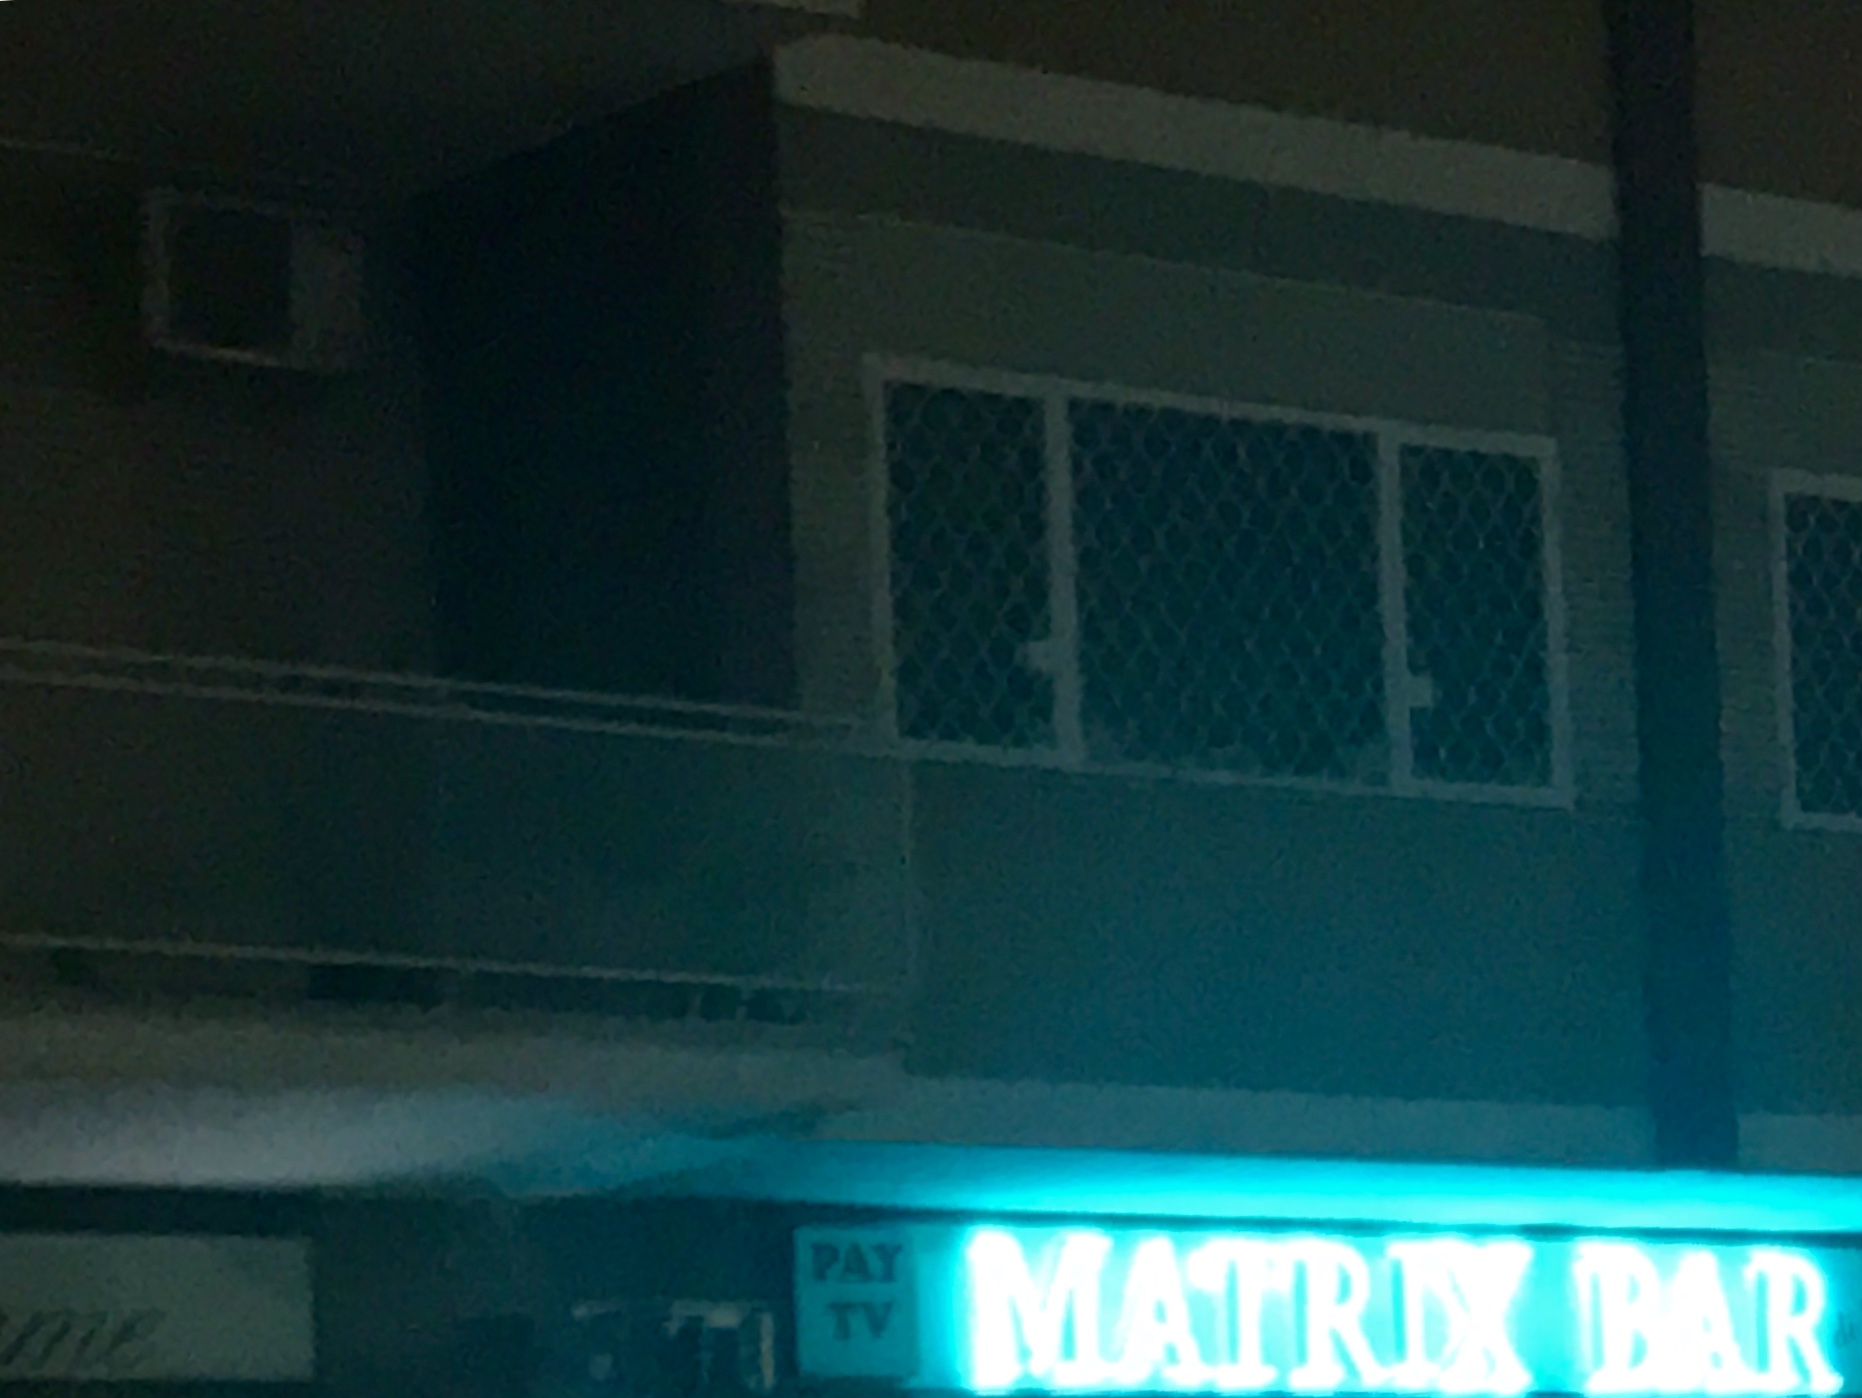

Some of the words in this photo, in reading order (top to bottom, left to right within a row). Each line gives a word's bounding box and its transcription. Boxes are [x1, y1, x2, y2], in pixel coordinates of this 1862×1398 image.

[810, 1241, 903, 1283] PAY
[824, 1301, 894, 1341] TV
[967, 1224, 1533, 1396] MATRIX
[1574, 1236, 1844, 1398] BAR
